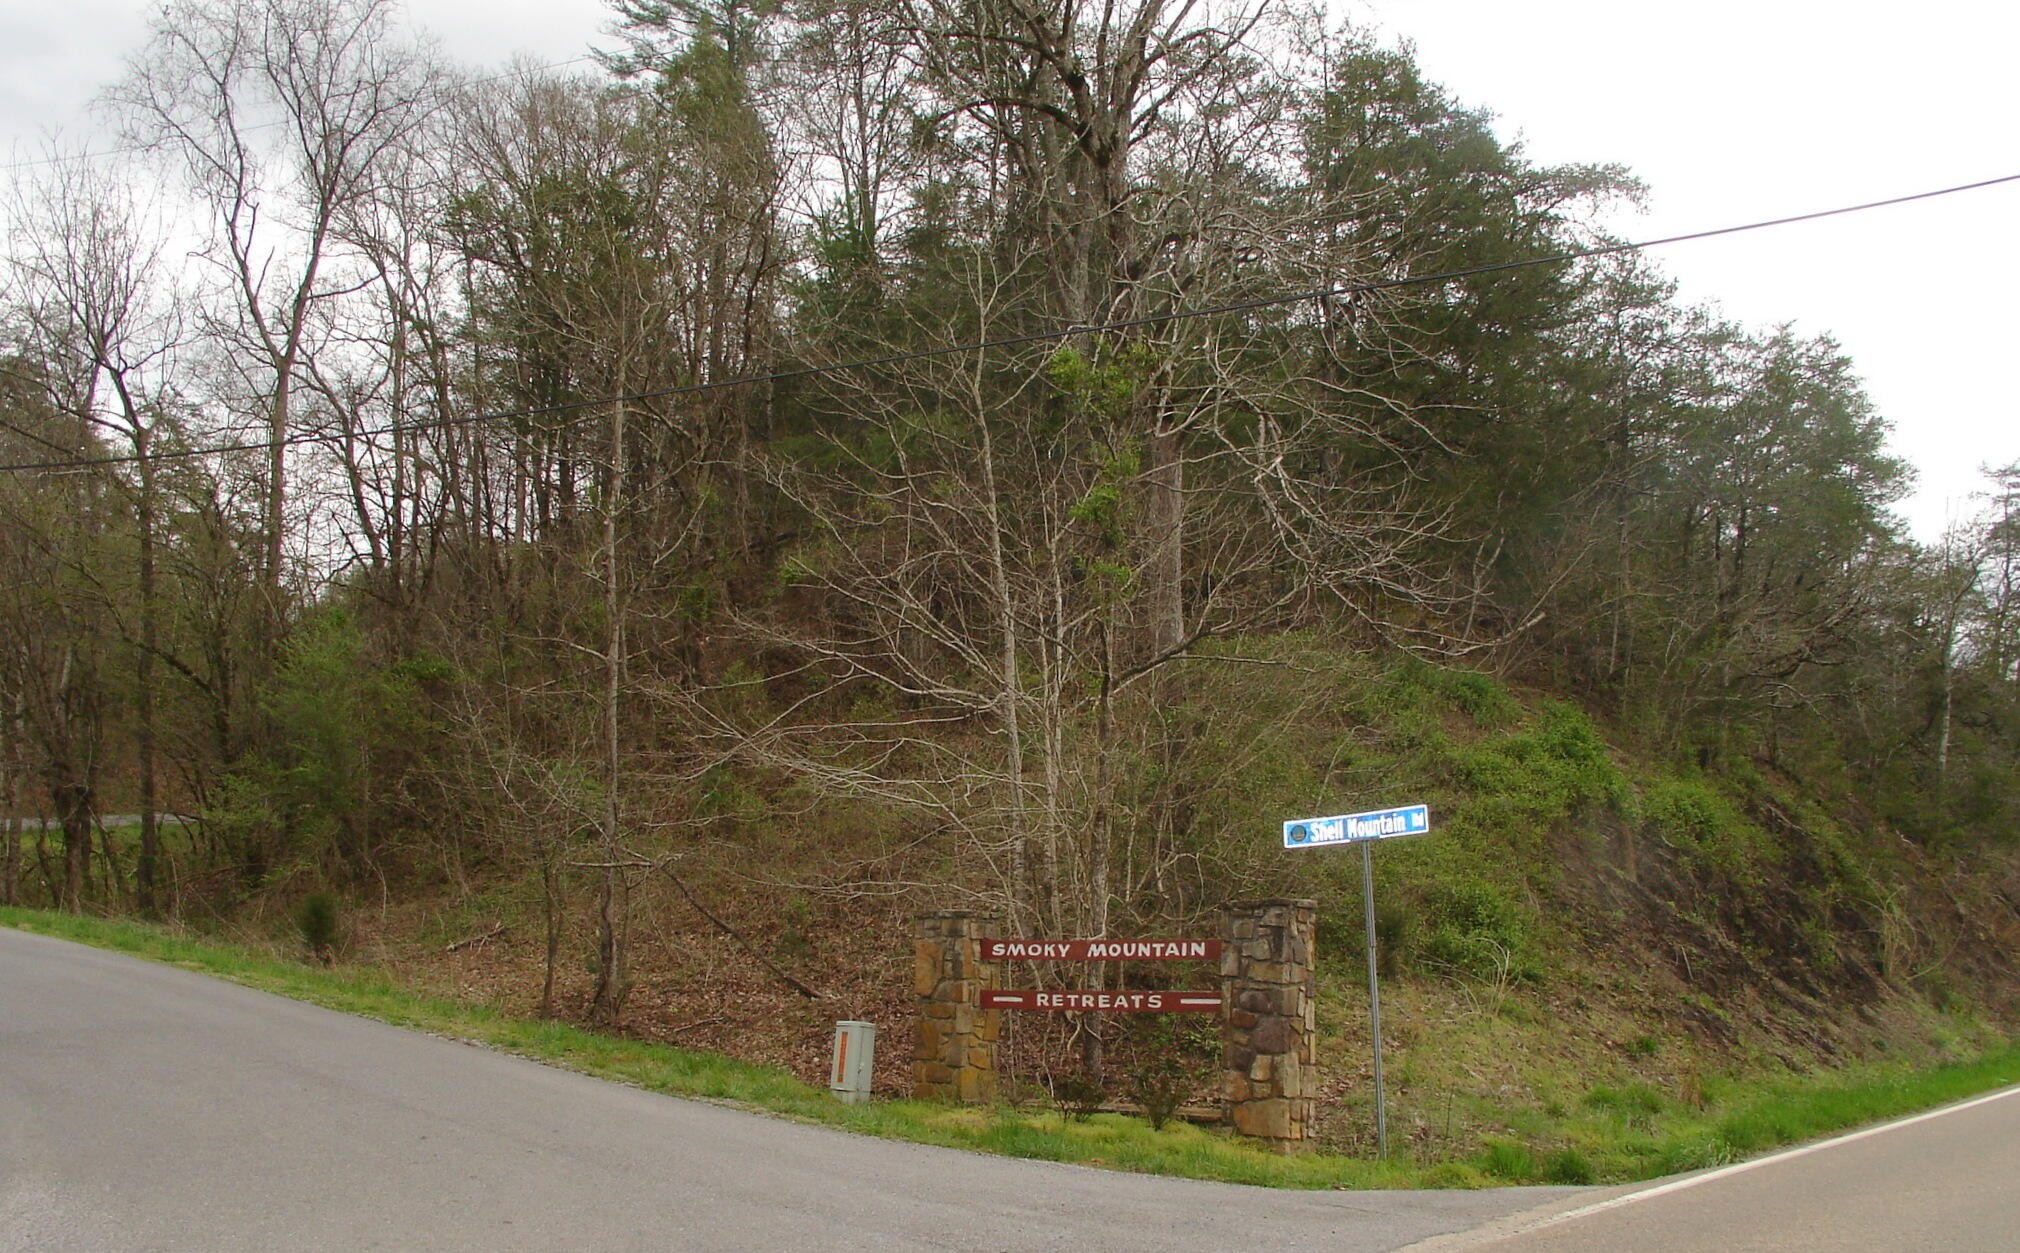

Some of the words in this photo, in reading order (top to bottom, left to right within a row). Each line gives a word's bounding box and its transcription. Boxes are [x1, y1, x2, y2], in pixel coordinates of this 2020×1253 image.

[1310, 820, 1344, 842] Shell
[1347, 813, 1407, 838] Mountain
[991, 942, 1071, 957] SMOKY
[1087, 941, 1206, 957] MOUNTAIN
[1036, 992, 1162, 1009] RETREATS
